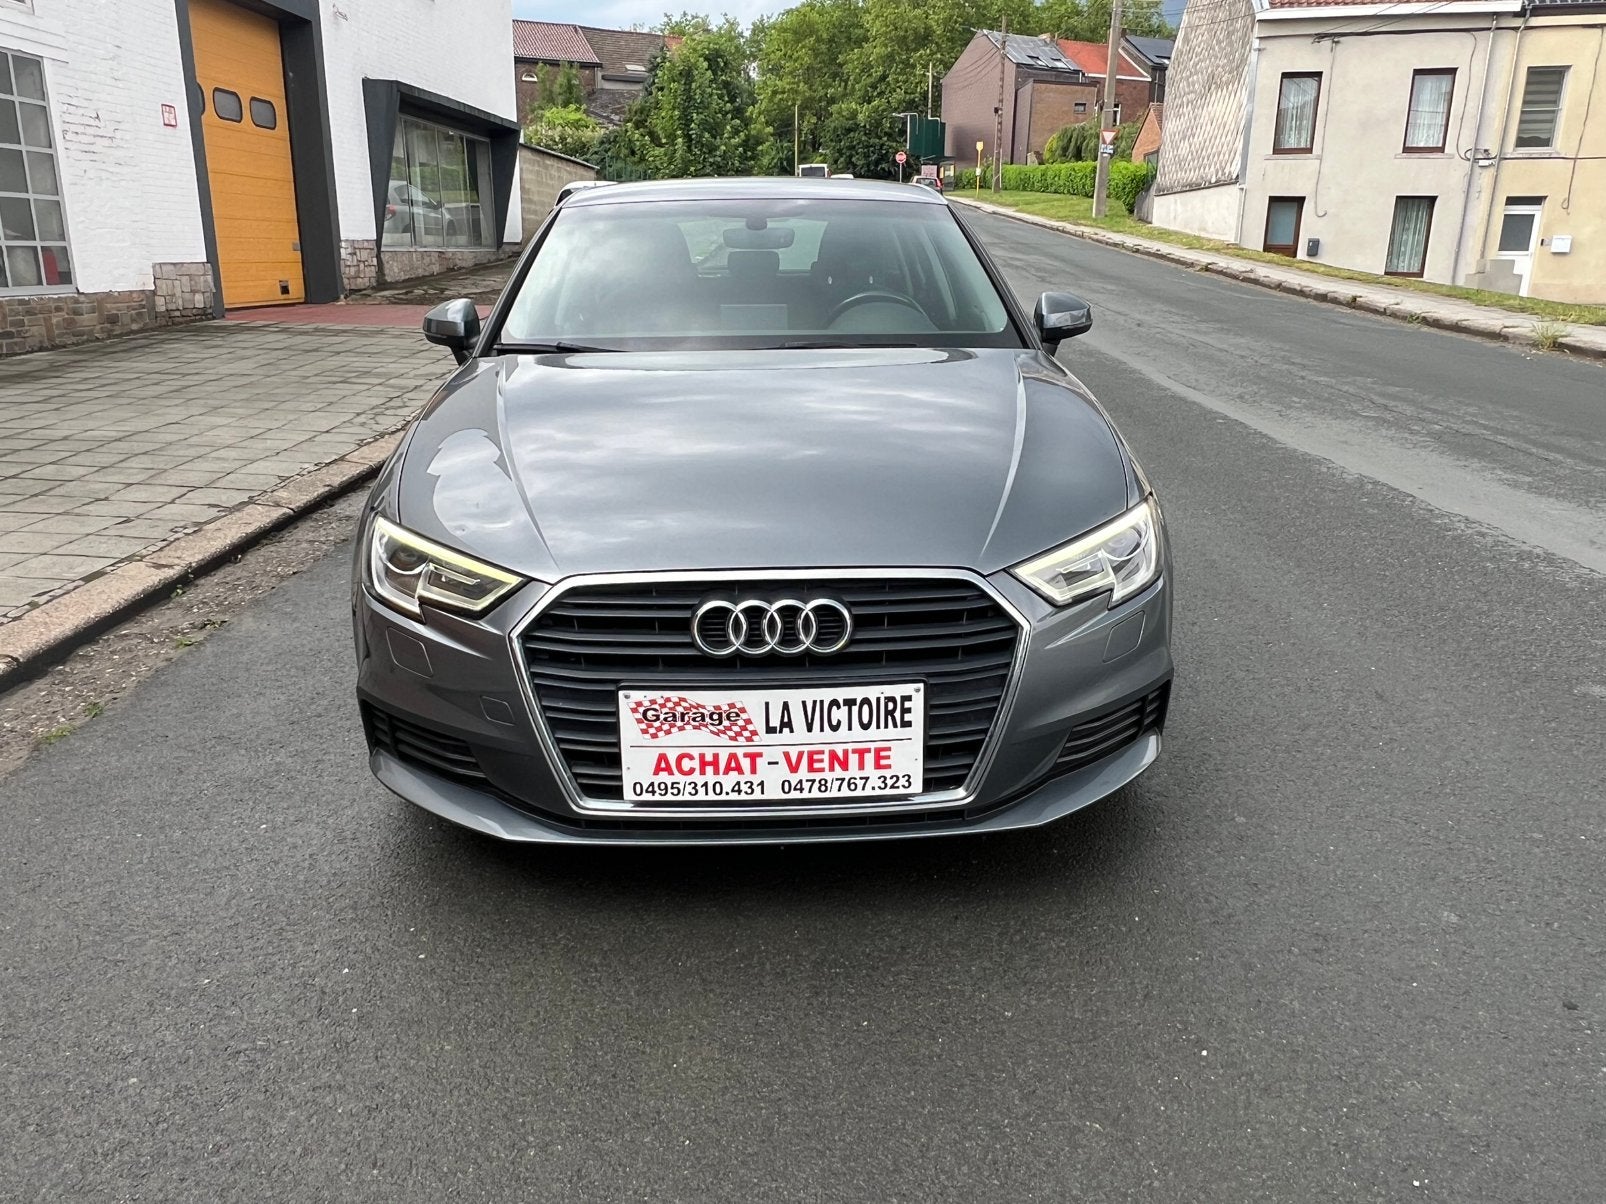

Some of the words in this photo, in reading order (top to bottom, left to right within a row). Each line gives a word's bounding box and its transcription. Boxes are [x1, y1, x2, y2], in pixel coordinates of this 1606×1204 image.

[641, 708, 741, 726] Garage
[764, 702, 795, 734] LA
[801, 694, 913, 733] VICTOIRE
[632, 780, 766, 797] 0495/310.431
[781, 774, 913, 795] 0478/767.323
